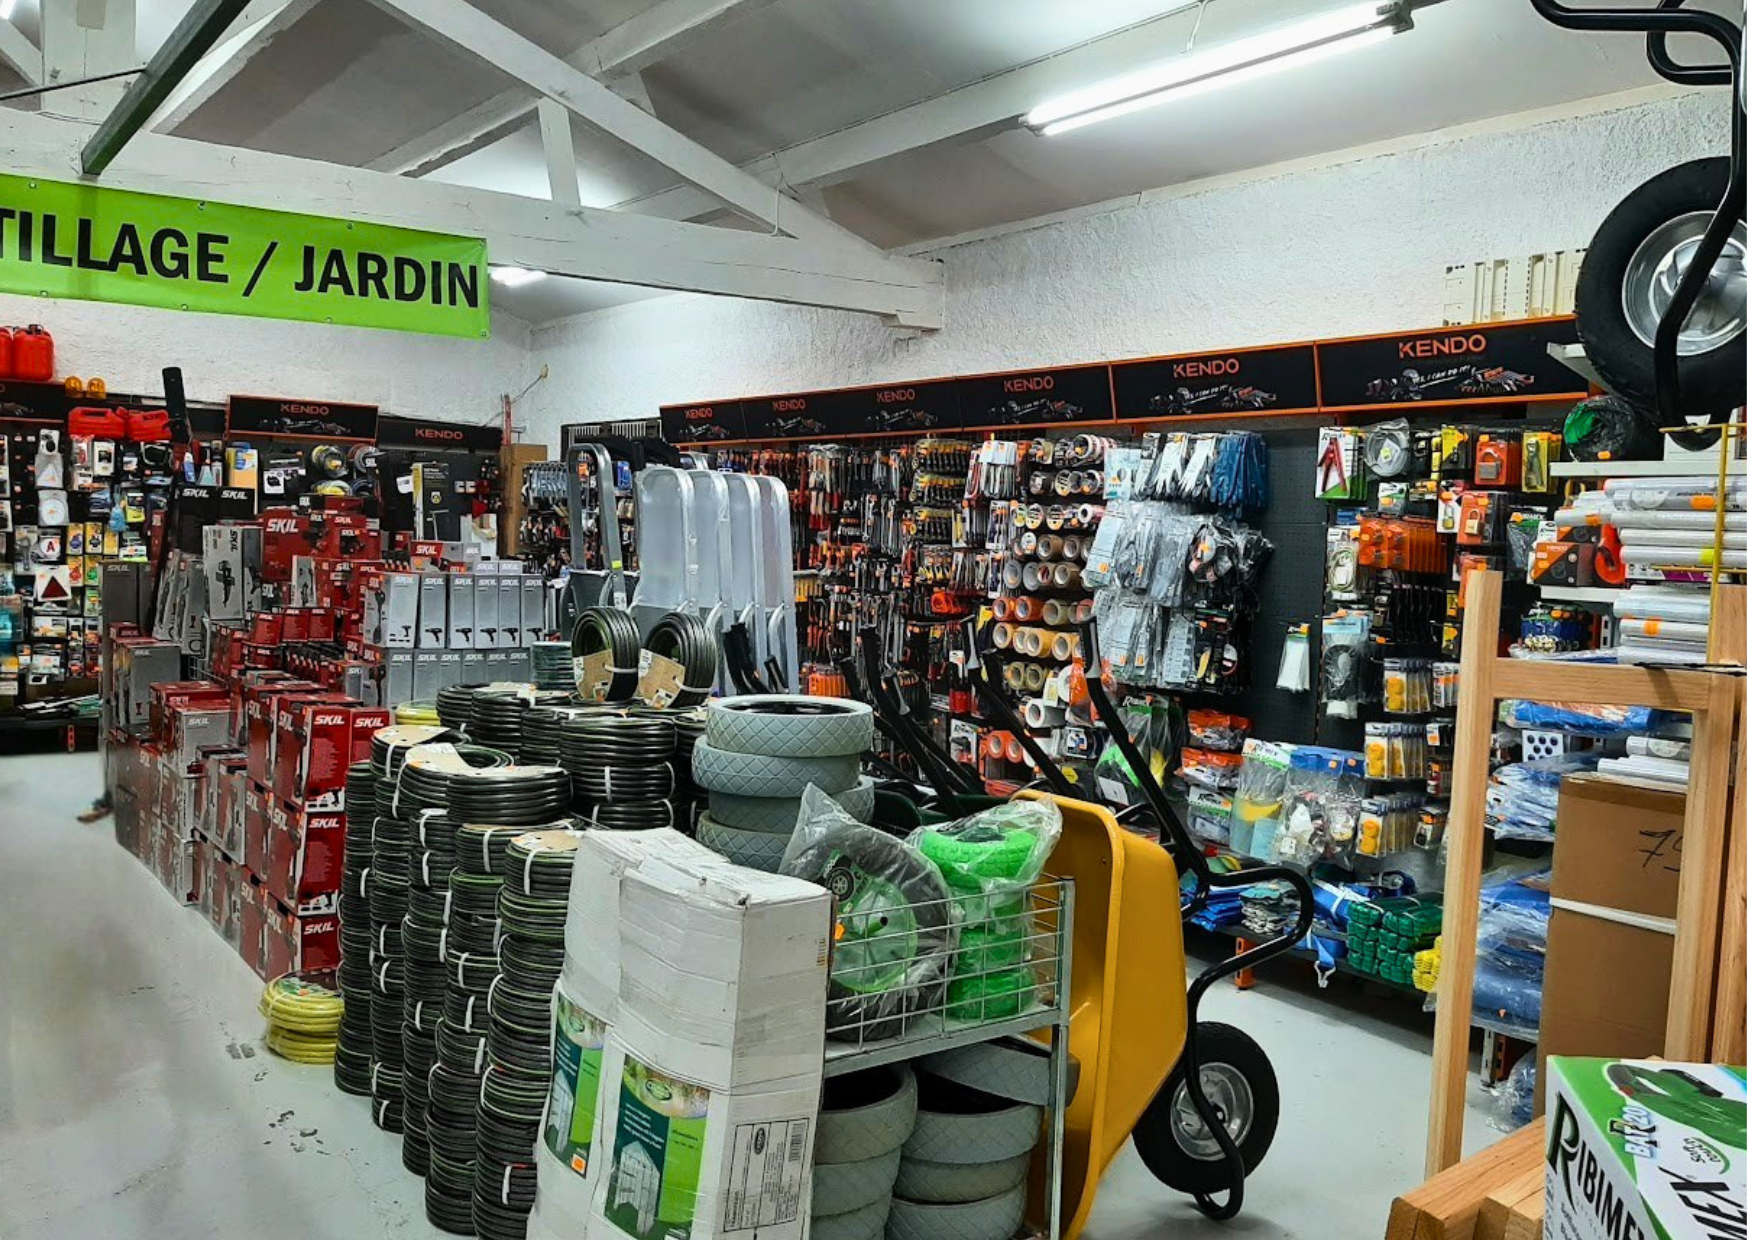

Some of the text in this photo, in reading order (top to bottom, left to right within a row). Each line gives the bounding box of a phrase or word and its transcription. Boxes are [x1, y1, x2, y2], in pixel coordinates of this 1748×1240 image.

[242, 242, 278, 297] /
[295, 245, 478, 308] JARDIN
[1400, 334, 1486, 358] KENDO
[1173, 358, 1240, 378] KENDO
[1004, 376, 1054, 392] KENDO
[876, 388, 915, 402] KENDO
[280, 404, 329, 416] KENDO
[772, 399, 806, 412] KENDO
[684, 408, 712, 419] KENDO
[414, 428, 463, 440] KENDO
[182, 488, 209, 498] SKIL
[221, 490, 248, 500] SKIL
[266, 518, 298, 534] SKIL
[46, 541, 55, 552] A
[230, 530, 238, 552] SKIL
[416, 545, 438, 554] SKIL
[476, 562, 496, 570] SKIL
[502, 562, 520, 570] SKIL
[394, 576, 414, 584] SKIL
[314, 716, 345, 725] SKIL
[354, 718, 384, 728] SKIL
[309, 818, 340, 828] SKIL
[304, 922, 334, 935] SKIL
[1546, 1090, 1645, 1240] RIBIM
